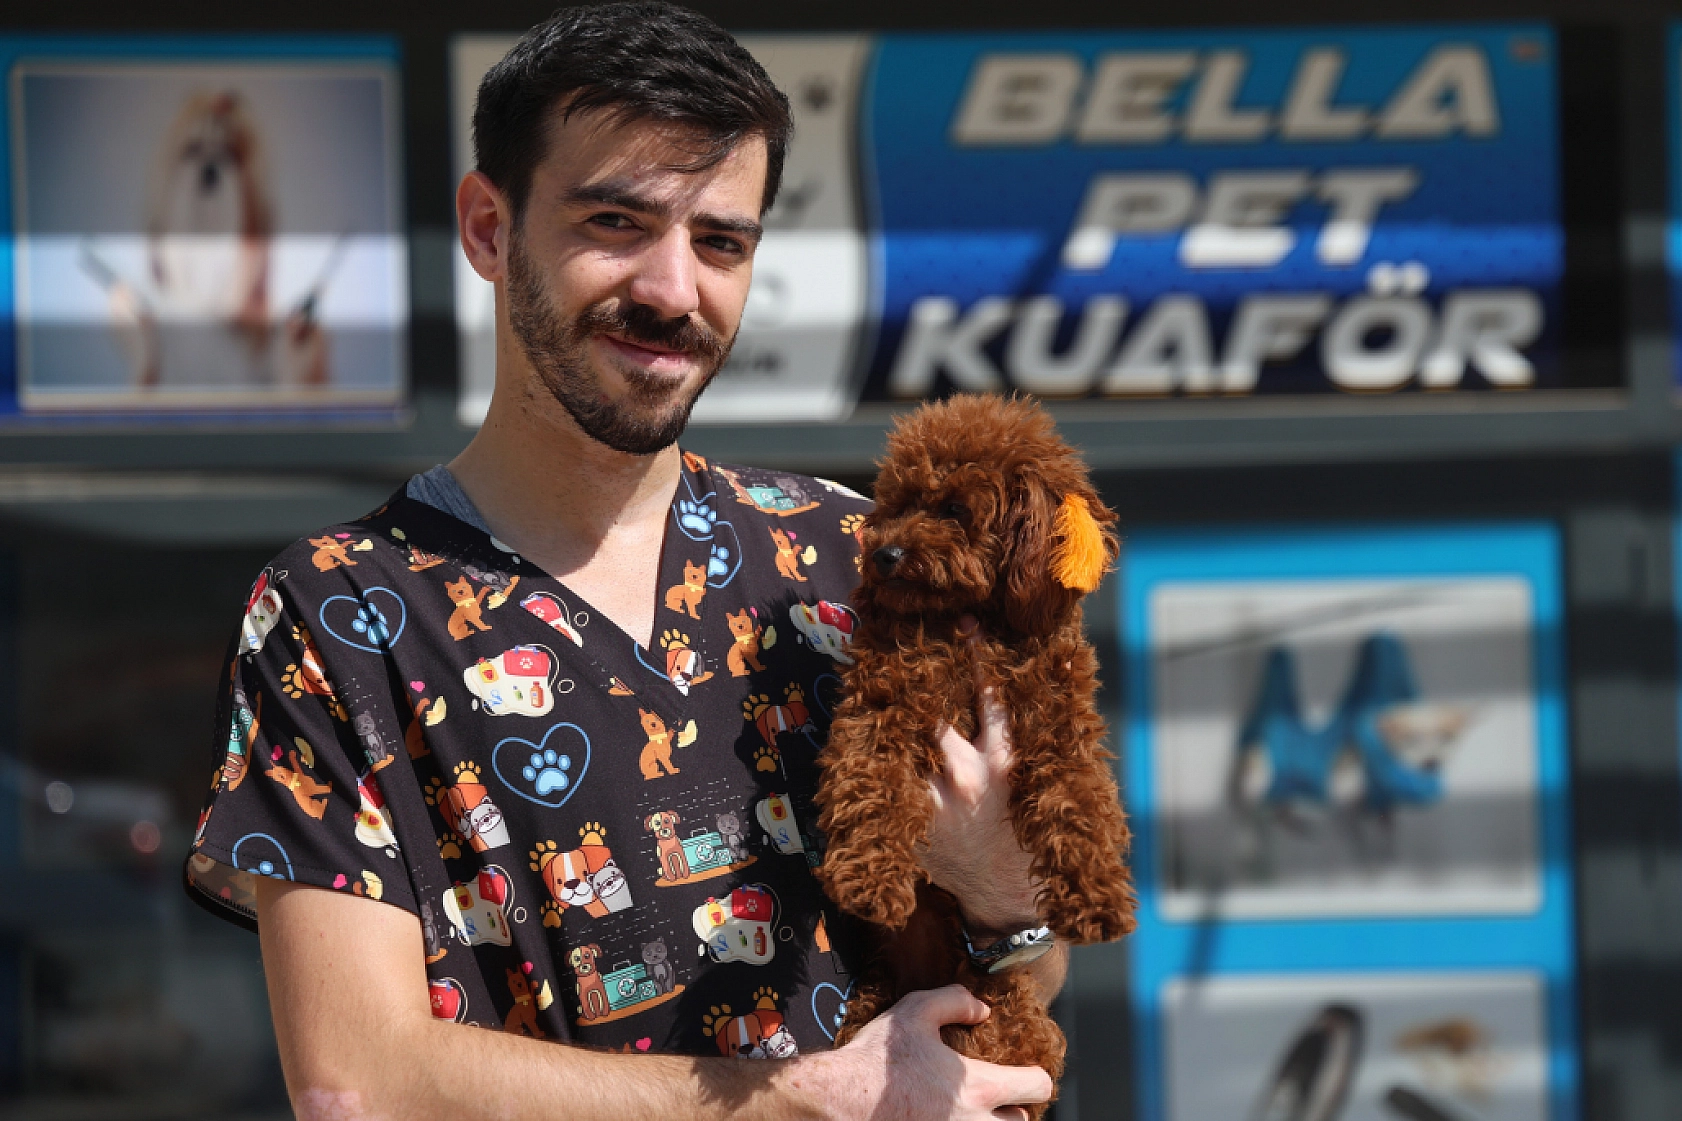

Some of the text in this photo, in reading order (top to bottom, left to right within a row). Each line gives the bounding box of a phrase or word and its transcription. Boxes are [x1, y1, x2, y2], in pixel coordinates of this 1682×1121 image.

[953, 47, 1499, 143] BELLA
[1062, 169, 1417, 268] PET
[891, 263, 1543, 393] KUAFÖR
